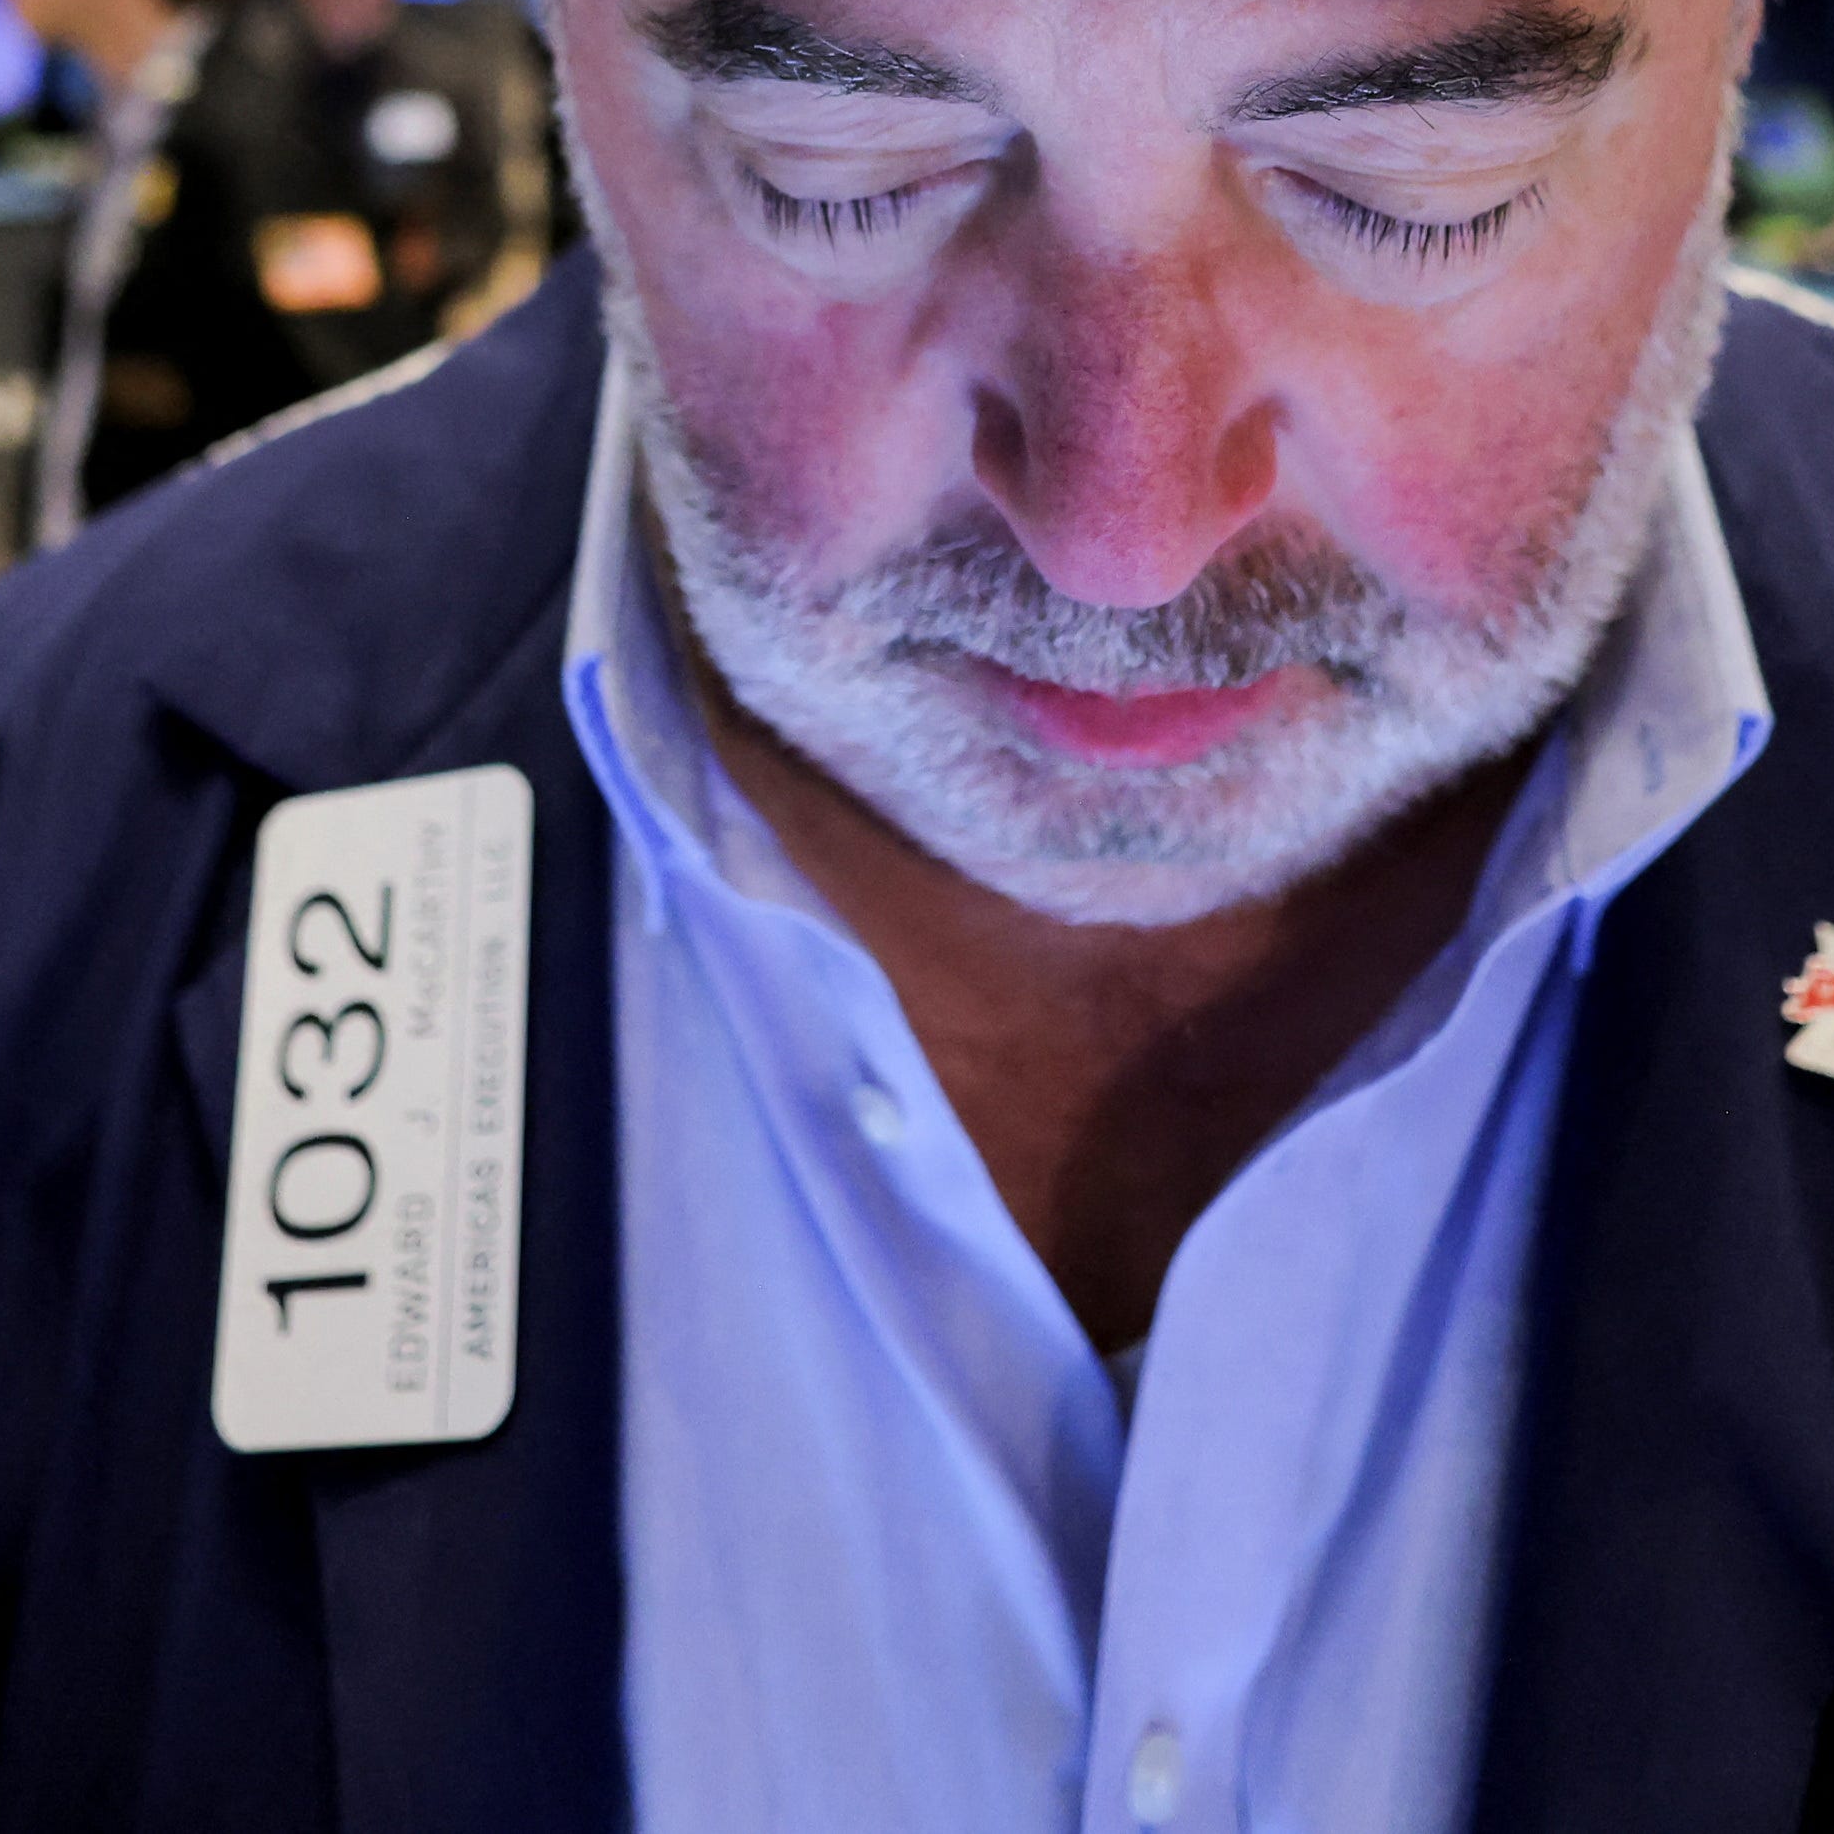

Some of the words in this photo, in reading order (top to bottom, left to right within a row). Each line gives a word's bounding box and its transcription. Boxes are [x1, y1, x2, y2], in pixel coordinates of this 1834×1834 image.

[260, 880, 396, 1333] 1032
[385, 1191, 436, 1395] EDWARD
[461, 1157, 503, 1360] AMERICAS
